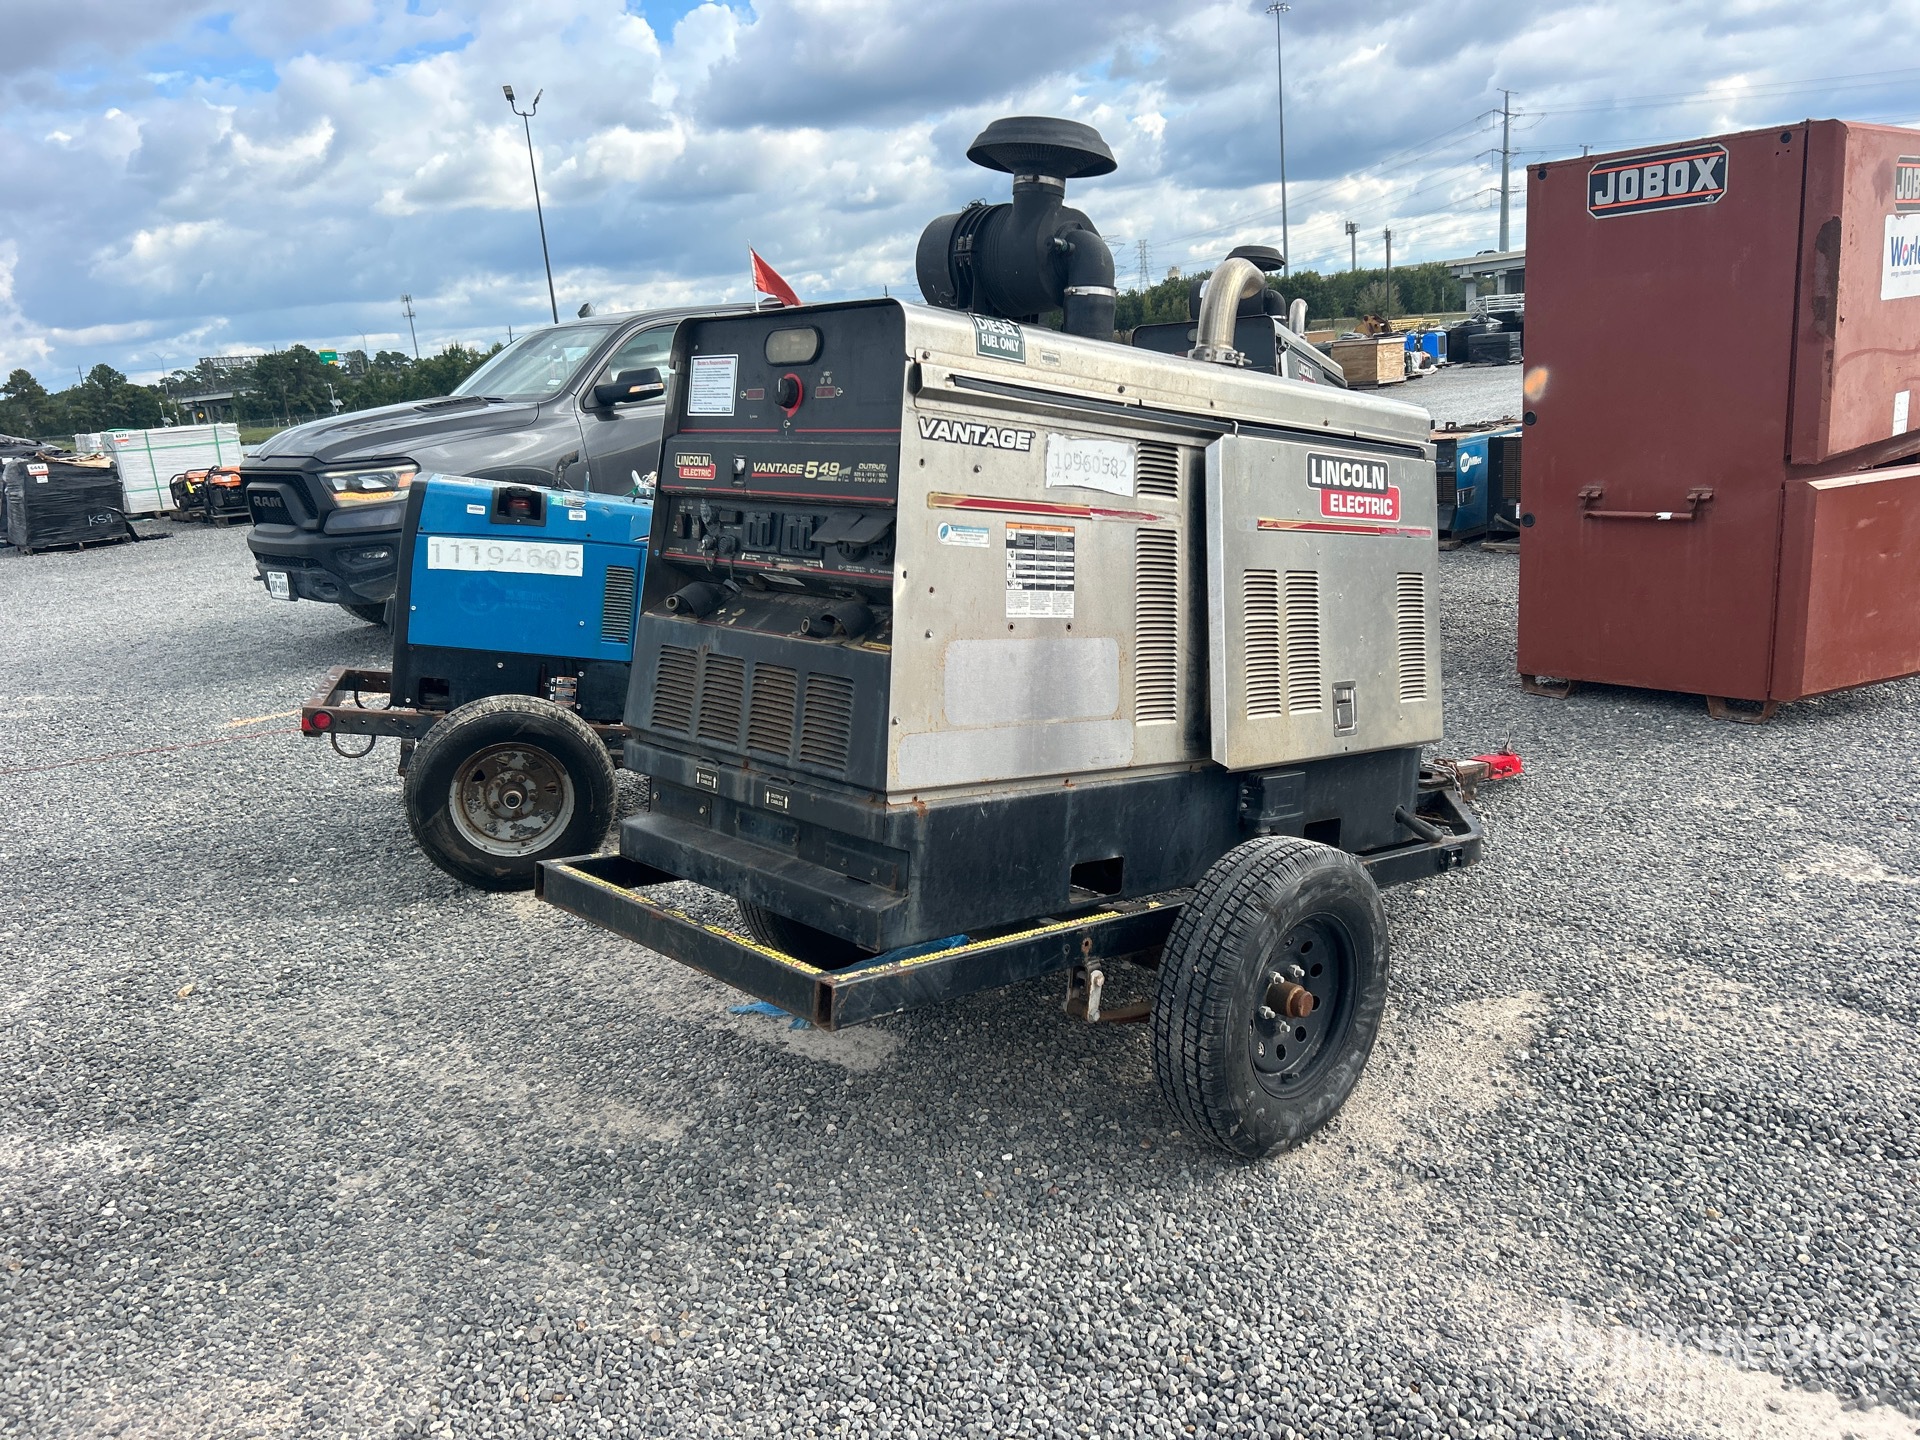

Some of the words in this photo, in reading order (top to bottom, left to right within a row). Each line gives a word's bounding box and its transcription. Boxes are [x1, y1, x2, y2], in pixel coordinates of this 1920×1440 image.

[1594, 155, 1720, 206] JOBOX
[976, 317, 1020, 338] DIESEL
[981, 335, 999, 349] FUEL
[1000, 337, 1020, 353] ONLY
[919, 416, 1033, 452] VANTAGE
[676, 454, 709, 468] LINCOLN
[752, 460, 804, 475] VANTAGE
[804, 461, 840, 479] 549
[682, 467, 713, 479] ELECTRIC
[1310, 457, 1385, 490] LINCOLN
[253, 495, 282, 508] RAM
[1329, 493, 1393, 517] ELECTRIC
[88, 512, 114, 527] K59
[700, 778, 712, 786] CABLES
[771, 798, 784, 806] CABLES
